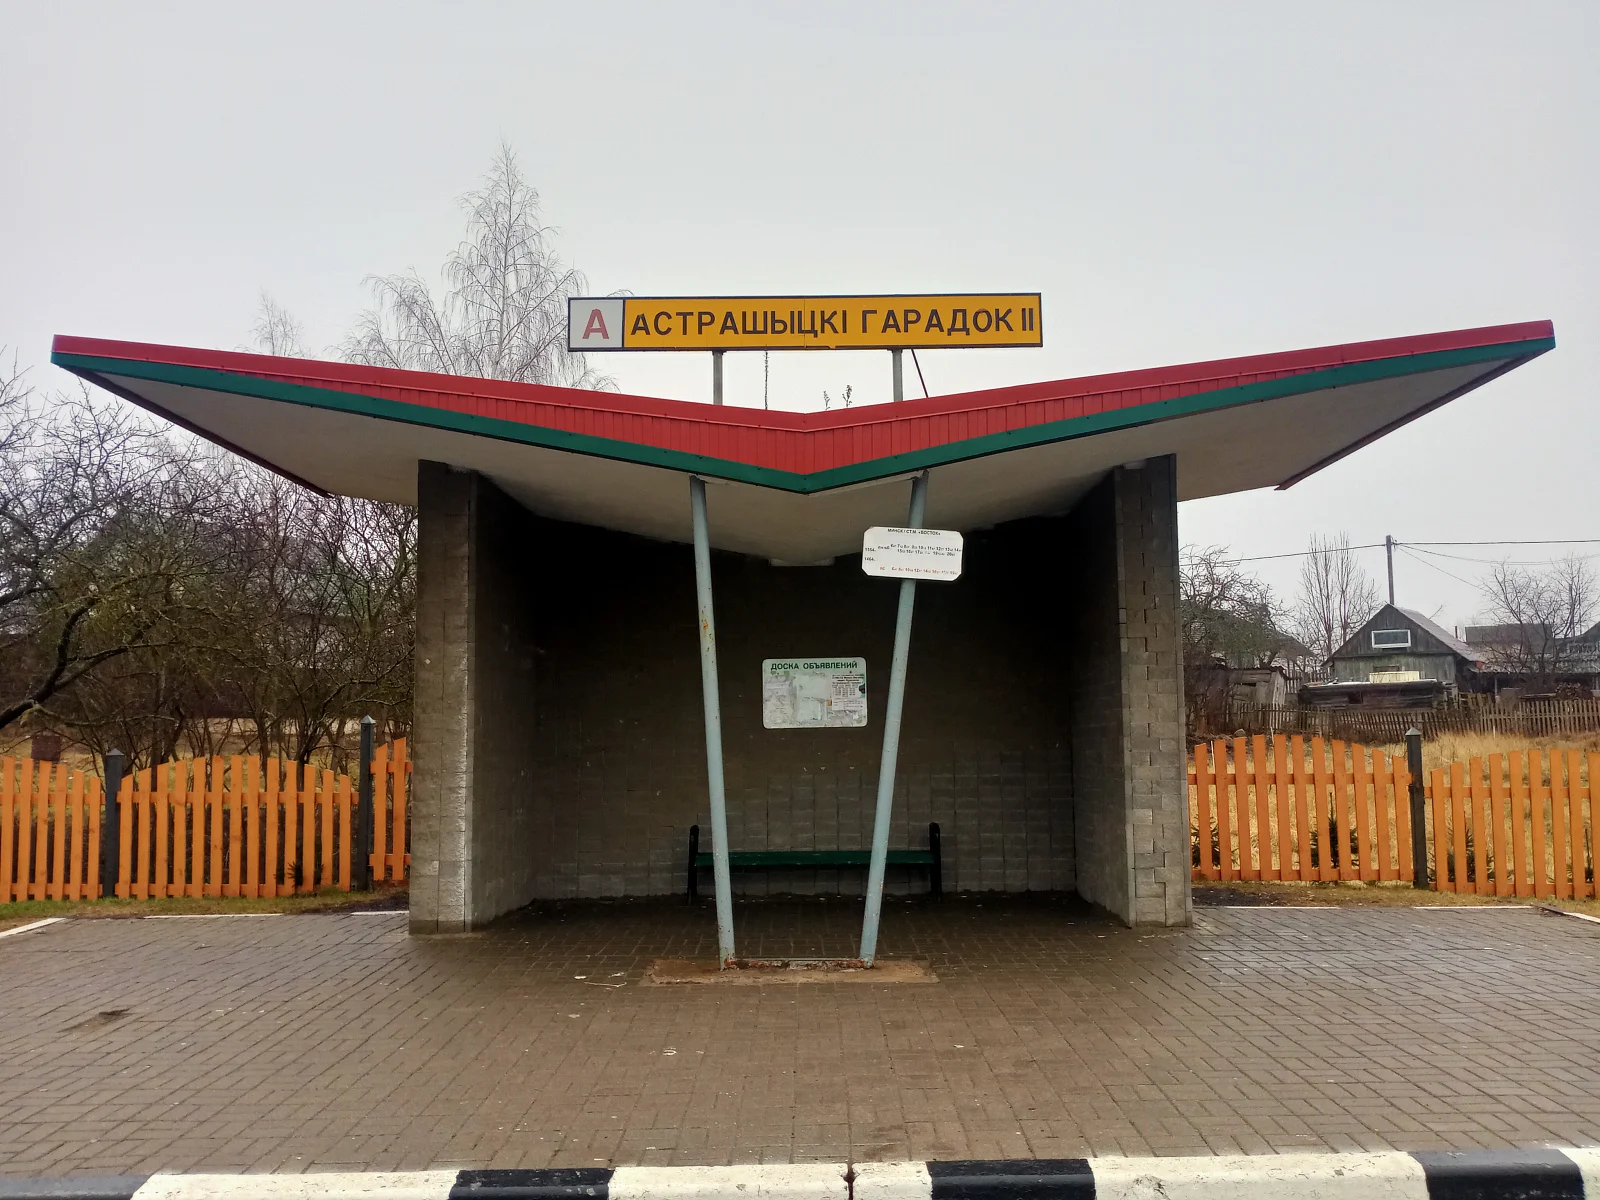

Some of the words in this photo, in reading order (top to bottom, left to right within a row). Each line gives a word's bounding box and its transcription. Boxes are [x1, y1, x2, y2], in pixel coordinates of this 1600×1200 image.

[582, 308, 610, 339] А
[630, 310, 847, 338] АСТРАШЫЦКІ
[861, 308, 1015, 336] ГАРАДОК
[770, 662, 800, 670] ДОСКА
[803, 661, 858, 669] ОБЪЯВЛЕНИЙ
